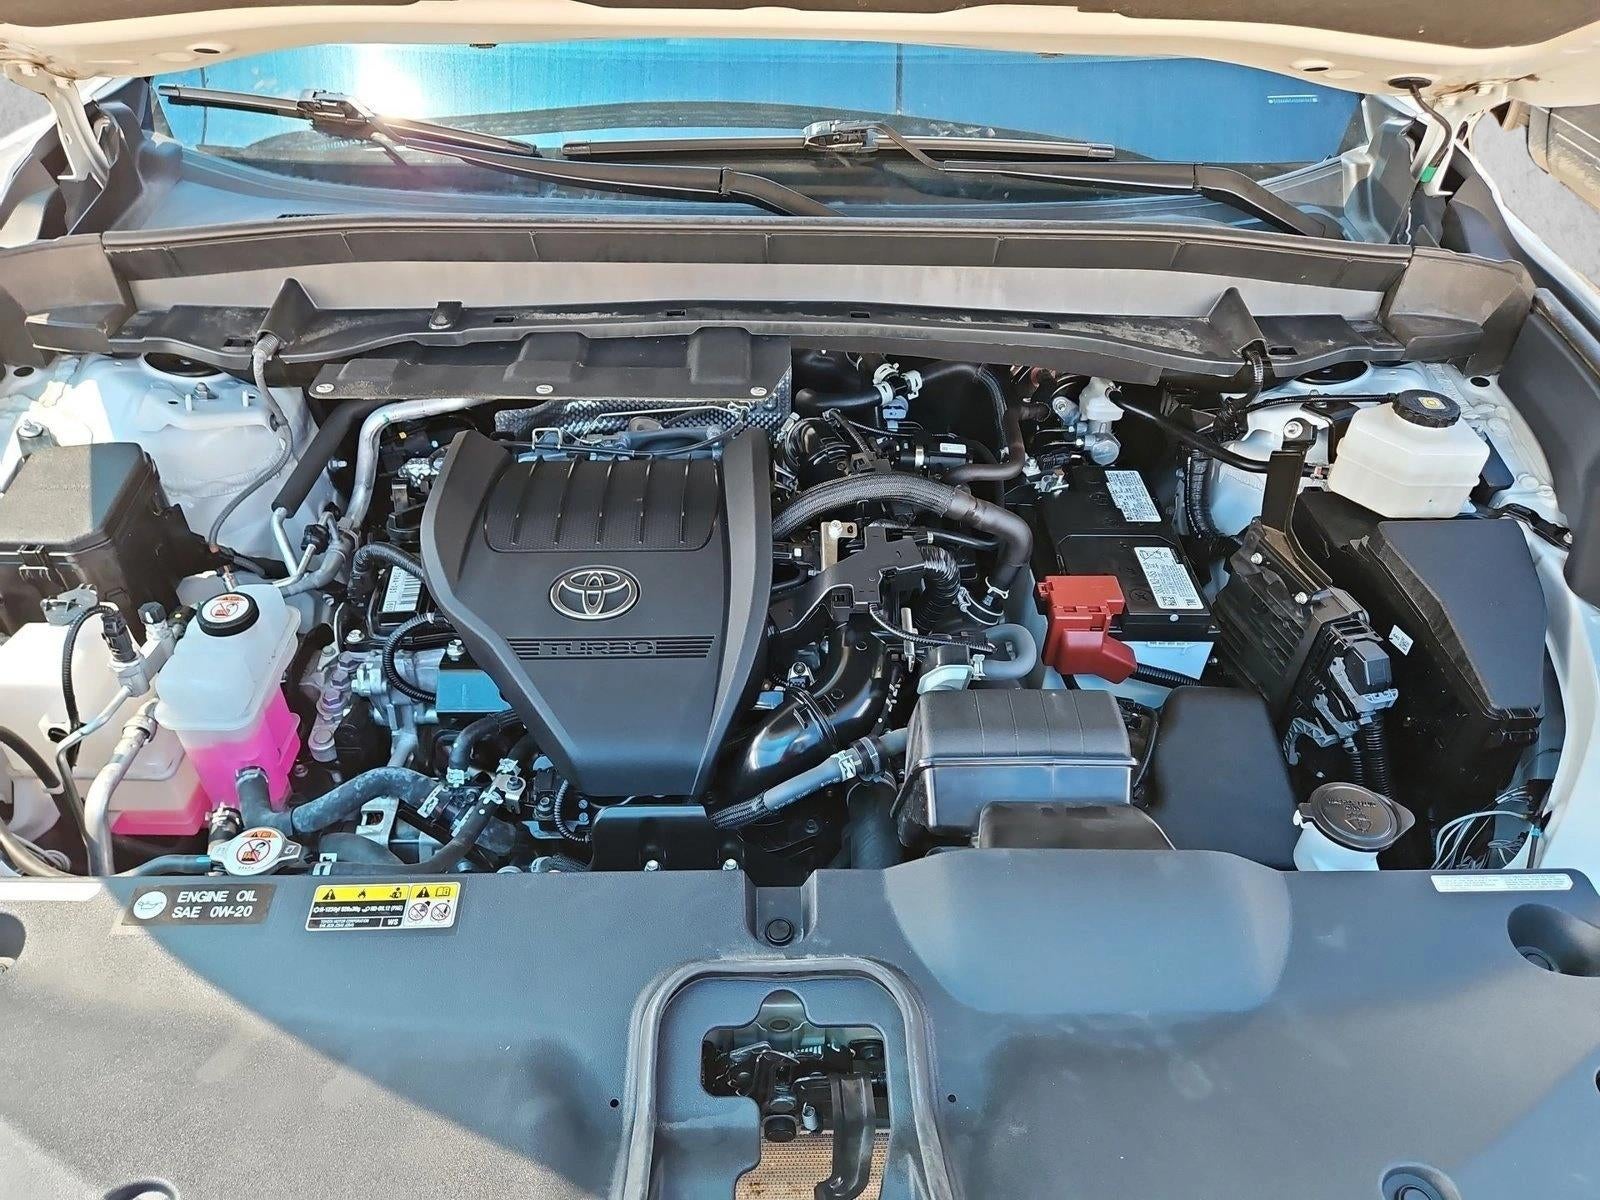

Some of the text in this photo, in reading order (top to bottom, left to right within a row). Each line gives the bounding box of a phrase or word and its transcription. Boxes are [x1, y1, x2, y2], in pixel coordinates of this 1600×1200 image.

[541, 639, 655, 655] TURBO
[177, 890, 257, 903] ENGINE OIL
[172, 905, 253, 918] SAE 0W-20
[387, 918, 399, 926] WS
